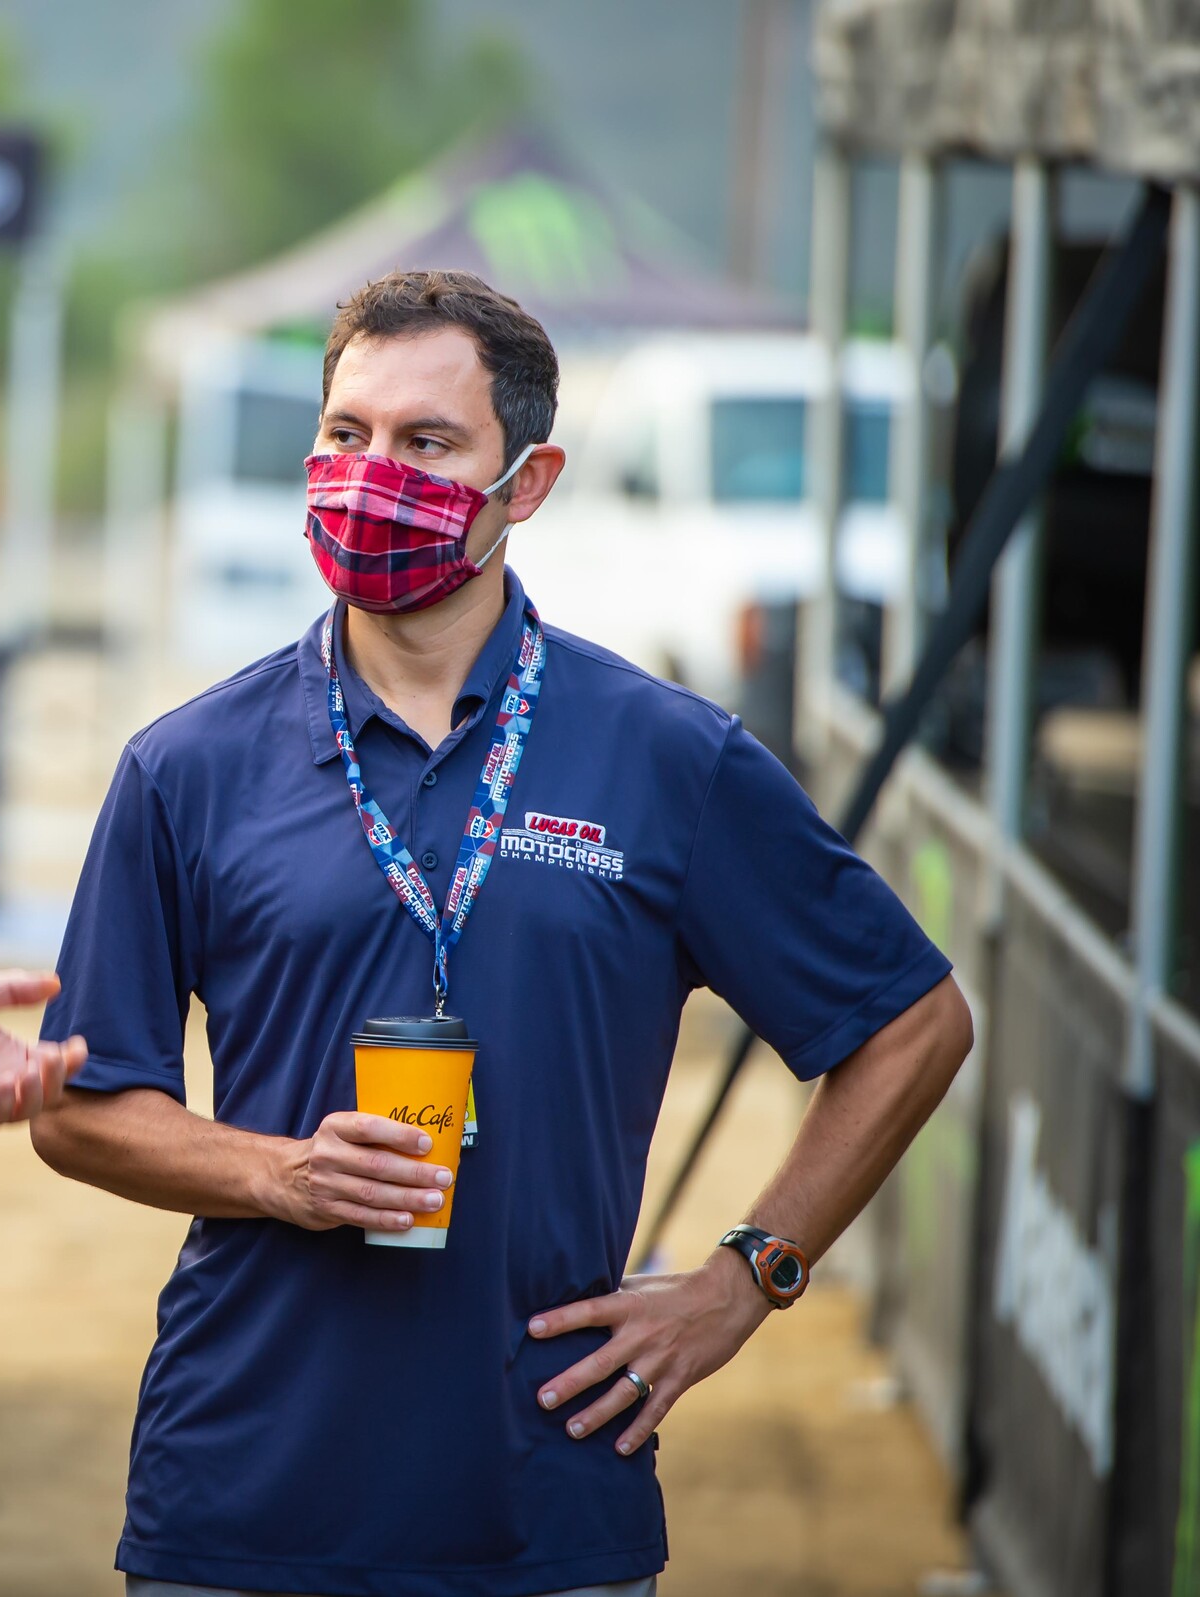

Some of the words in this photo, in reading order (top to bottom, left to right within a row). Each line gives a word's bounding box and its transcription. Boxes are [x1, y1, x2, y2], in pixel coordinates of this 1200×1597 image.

[525, 632, 543, 683] MOTOCRO
[484, 757, 498, 783] LUCAS
[492, 745, 502, 758] OIL
[492, 732, 519, 802] MOTOCROSS
[529, 816, 578, 837] LUCAS
[579, 824, 603, 843] OIL
[547, 836, 582, 848] PRO
[500, 835, 624, 872] MOTOCROSS
[500, 850, 623, 880] CHAMPIONSHIP
[387, 862, 436, 931] MOTOCROSS
[408, 870, 427, 895] LUCAS
[449, 882, 463, 911] LUCAS
[457, 869, 467, 883] OIL
[453, 856, 484, 933] MOTOCROSS
[388, 1104, 453, 1134] McCafé
